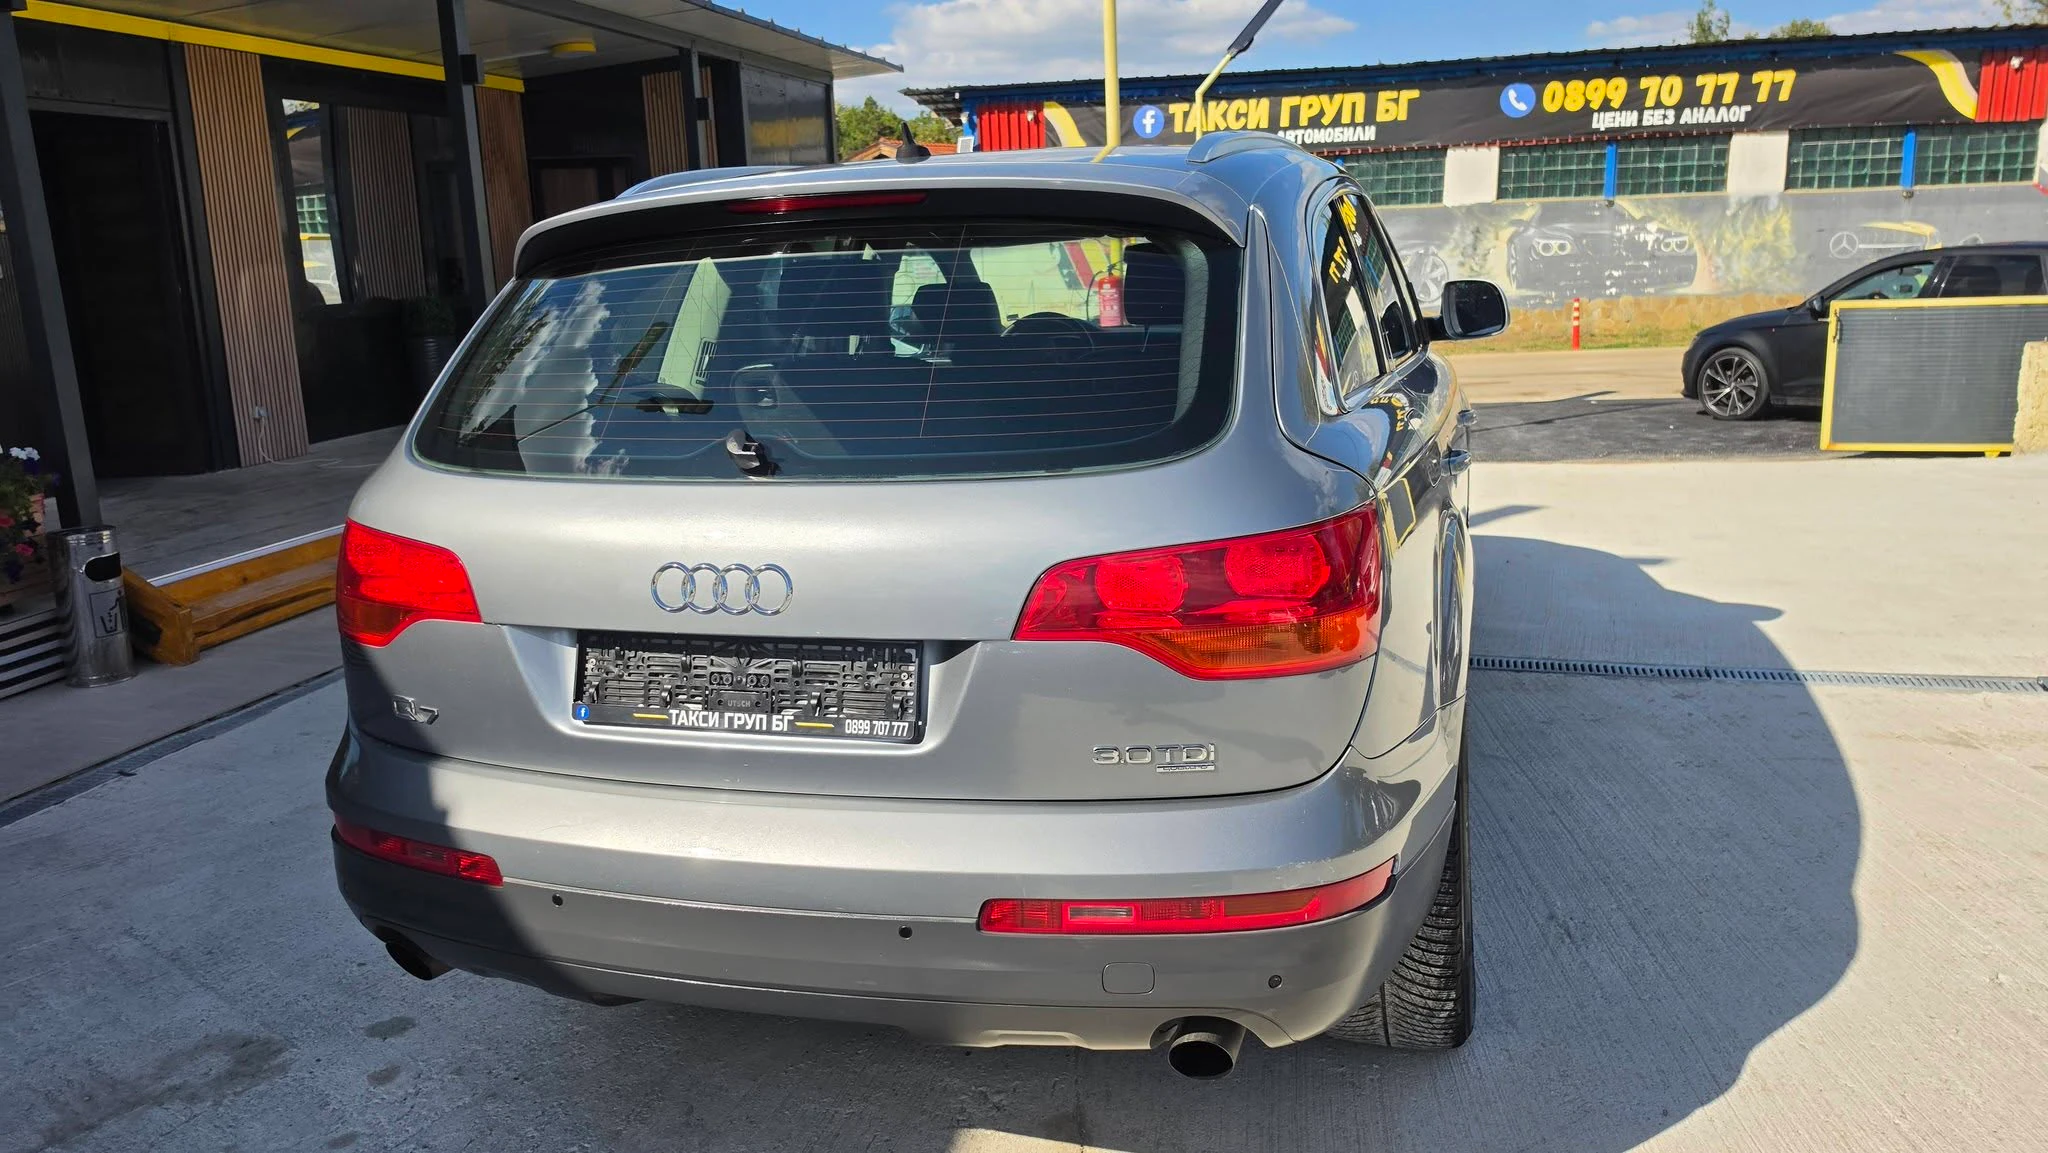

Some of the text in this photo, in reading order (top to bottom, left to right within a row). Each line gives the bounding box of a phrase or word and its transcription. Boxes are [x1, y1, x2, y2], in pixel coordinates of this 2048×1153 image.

[1543, 69, 1796, 113] 0899 70 77 77
[1168, 89, 1420, 133] ТАКСИ ГРУП БГ
[1592, 104, 1751, 130] ЦЕНИ БЕЗ АНАЛОГ
[669, 709, 795, 732] ТАКСИ ГРУП БГ
[845, 719, 909, 737] 0899 707 777
